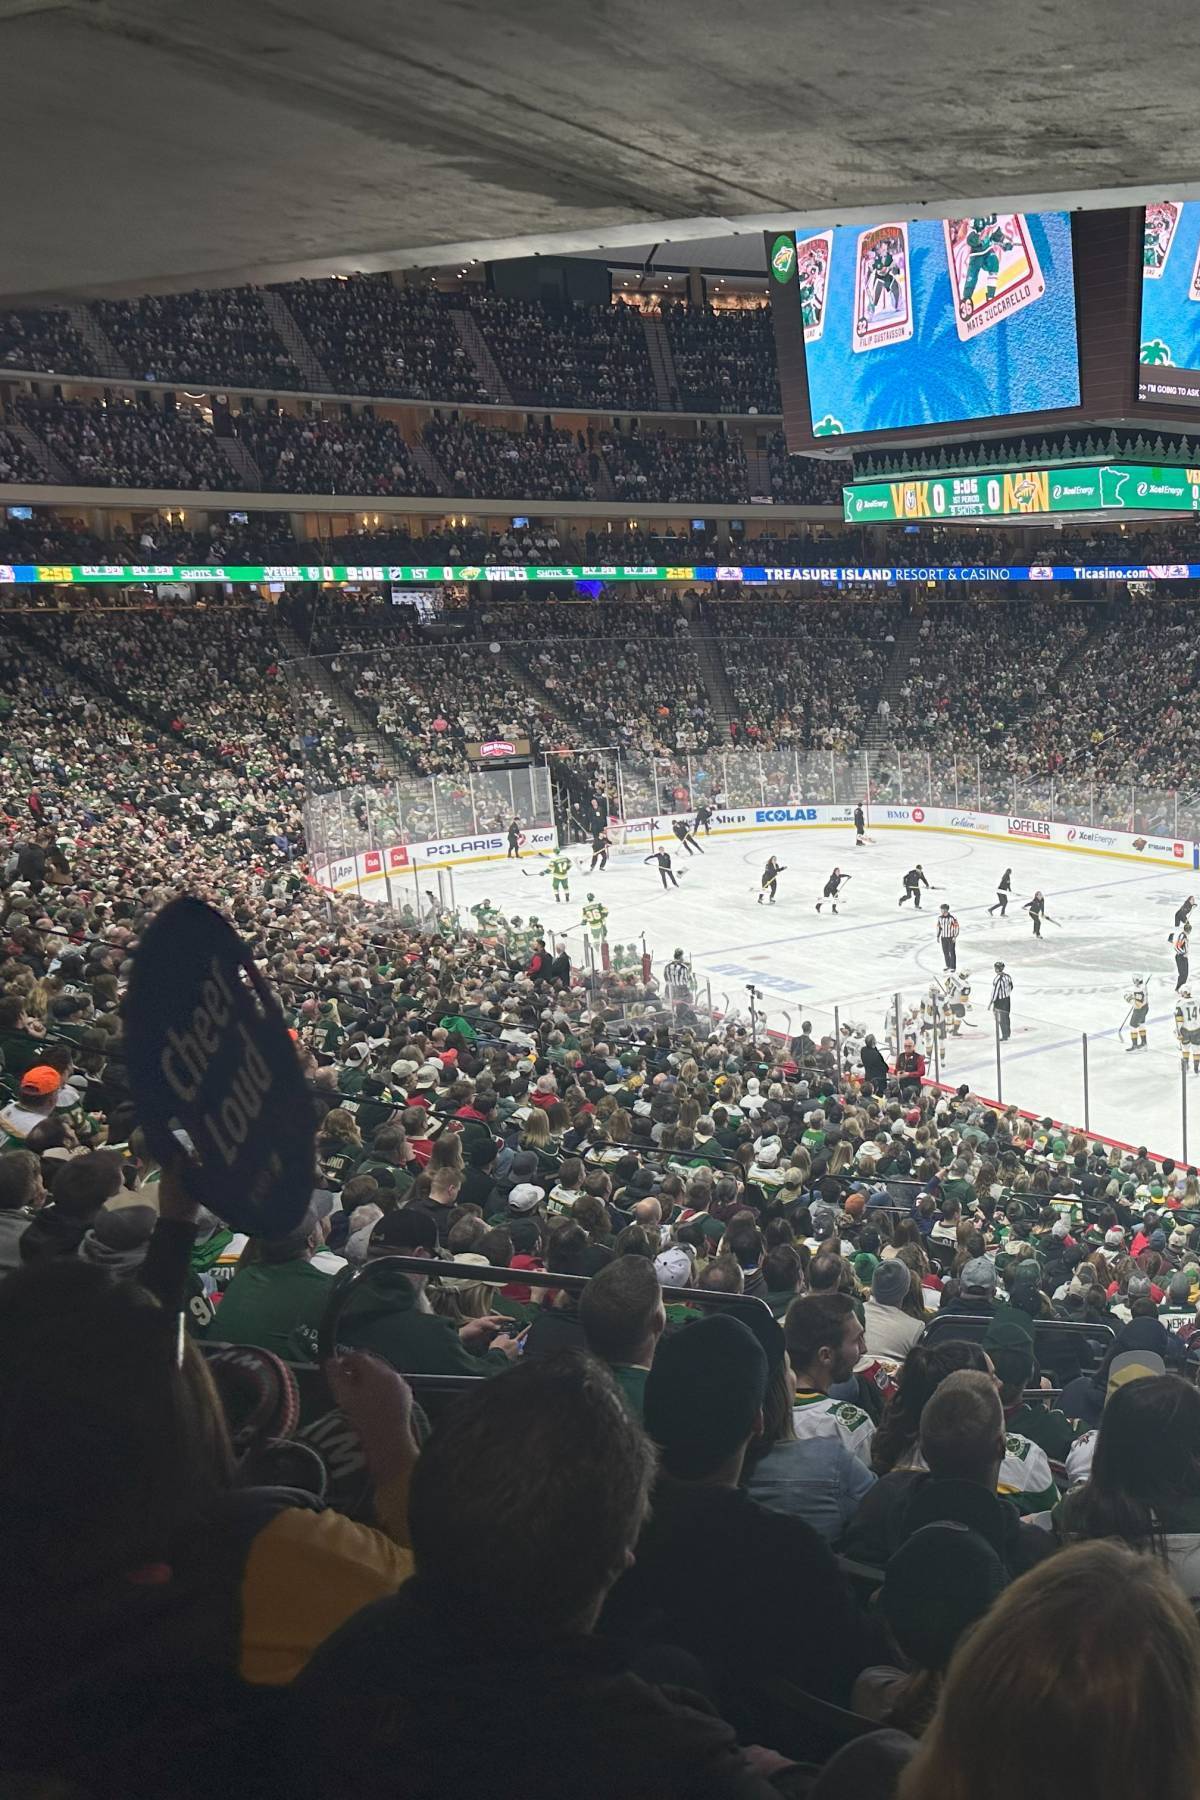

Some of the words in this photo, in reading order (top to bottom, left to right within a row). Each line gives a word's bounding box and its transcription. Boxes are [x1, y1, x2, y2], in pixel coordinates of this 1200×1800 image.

[960, 302, 973, 318] 36
[966, 314, 984, 333] MATS
[985, 286, 1032, 323] ZUCCARELLO
[858, 320, 868, 334] 32
[859, 336, 874, 348] FILIP
[1157, 385, 1177, 394] GOING
[1178, 387, 1186, 396] TO
[1186, 388, 1200, 397] ASK
[953, 478, 978, 494] 9:06
[1192, 485, 1199, 499] 0
[932, 484, 944, 513] 0
[952, 495, 961, 503] 1ST
[962, 494, 980, 503] PERIOD
[987, 480, 1000, 510] 0
[958, 505, 977, 515] SHOTS
[1193, 501, 1198, 510] 9
[39, 568, 73, 581] 2:56
[266, 567, 299, 576] VEGAS
[323, 567, 334, 580] 0
[347, 567, 383, 580] 9:06
[412, 569, 428, 578] 1ST
[444, 567, 452, 580] 0
[486, 570, 528, 580] WILD
[666, 568, 693, 580] 2:56
[764, 568, 838, 580] TREASURE
[841, 568, 892, 580] ISLAND
[896, 568, 944, 580] RESORT
[948, 569, 957, 580] &
[960, 568, 1010, 580] CASINO
[1074, 567, 1148, 579] TIcasino.com
[756, 808, 817, 822] ECOLAB
[887, 811, 910, 819] BMO
[1008, 818, 1050, 834] LOFFLER
[531, 833, 553, 843] Xcel
[427, 839, 503, 857] POLARIS
[1186, 1007, 1198, 1021] 14
[190, 1296, 212, 1325] 9
